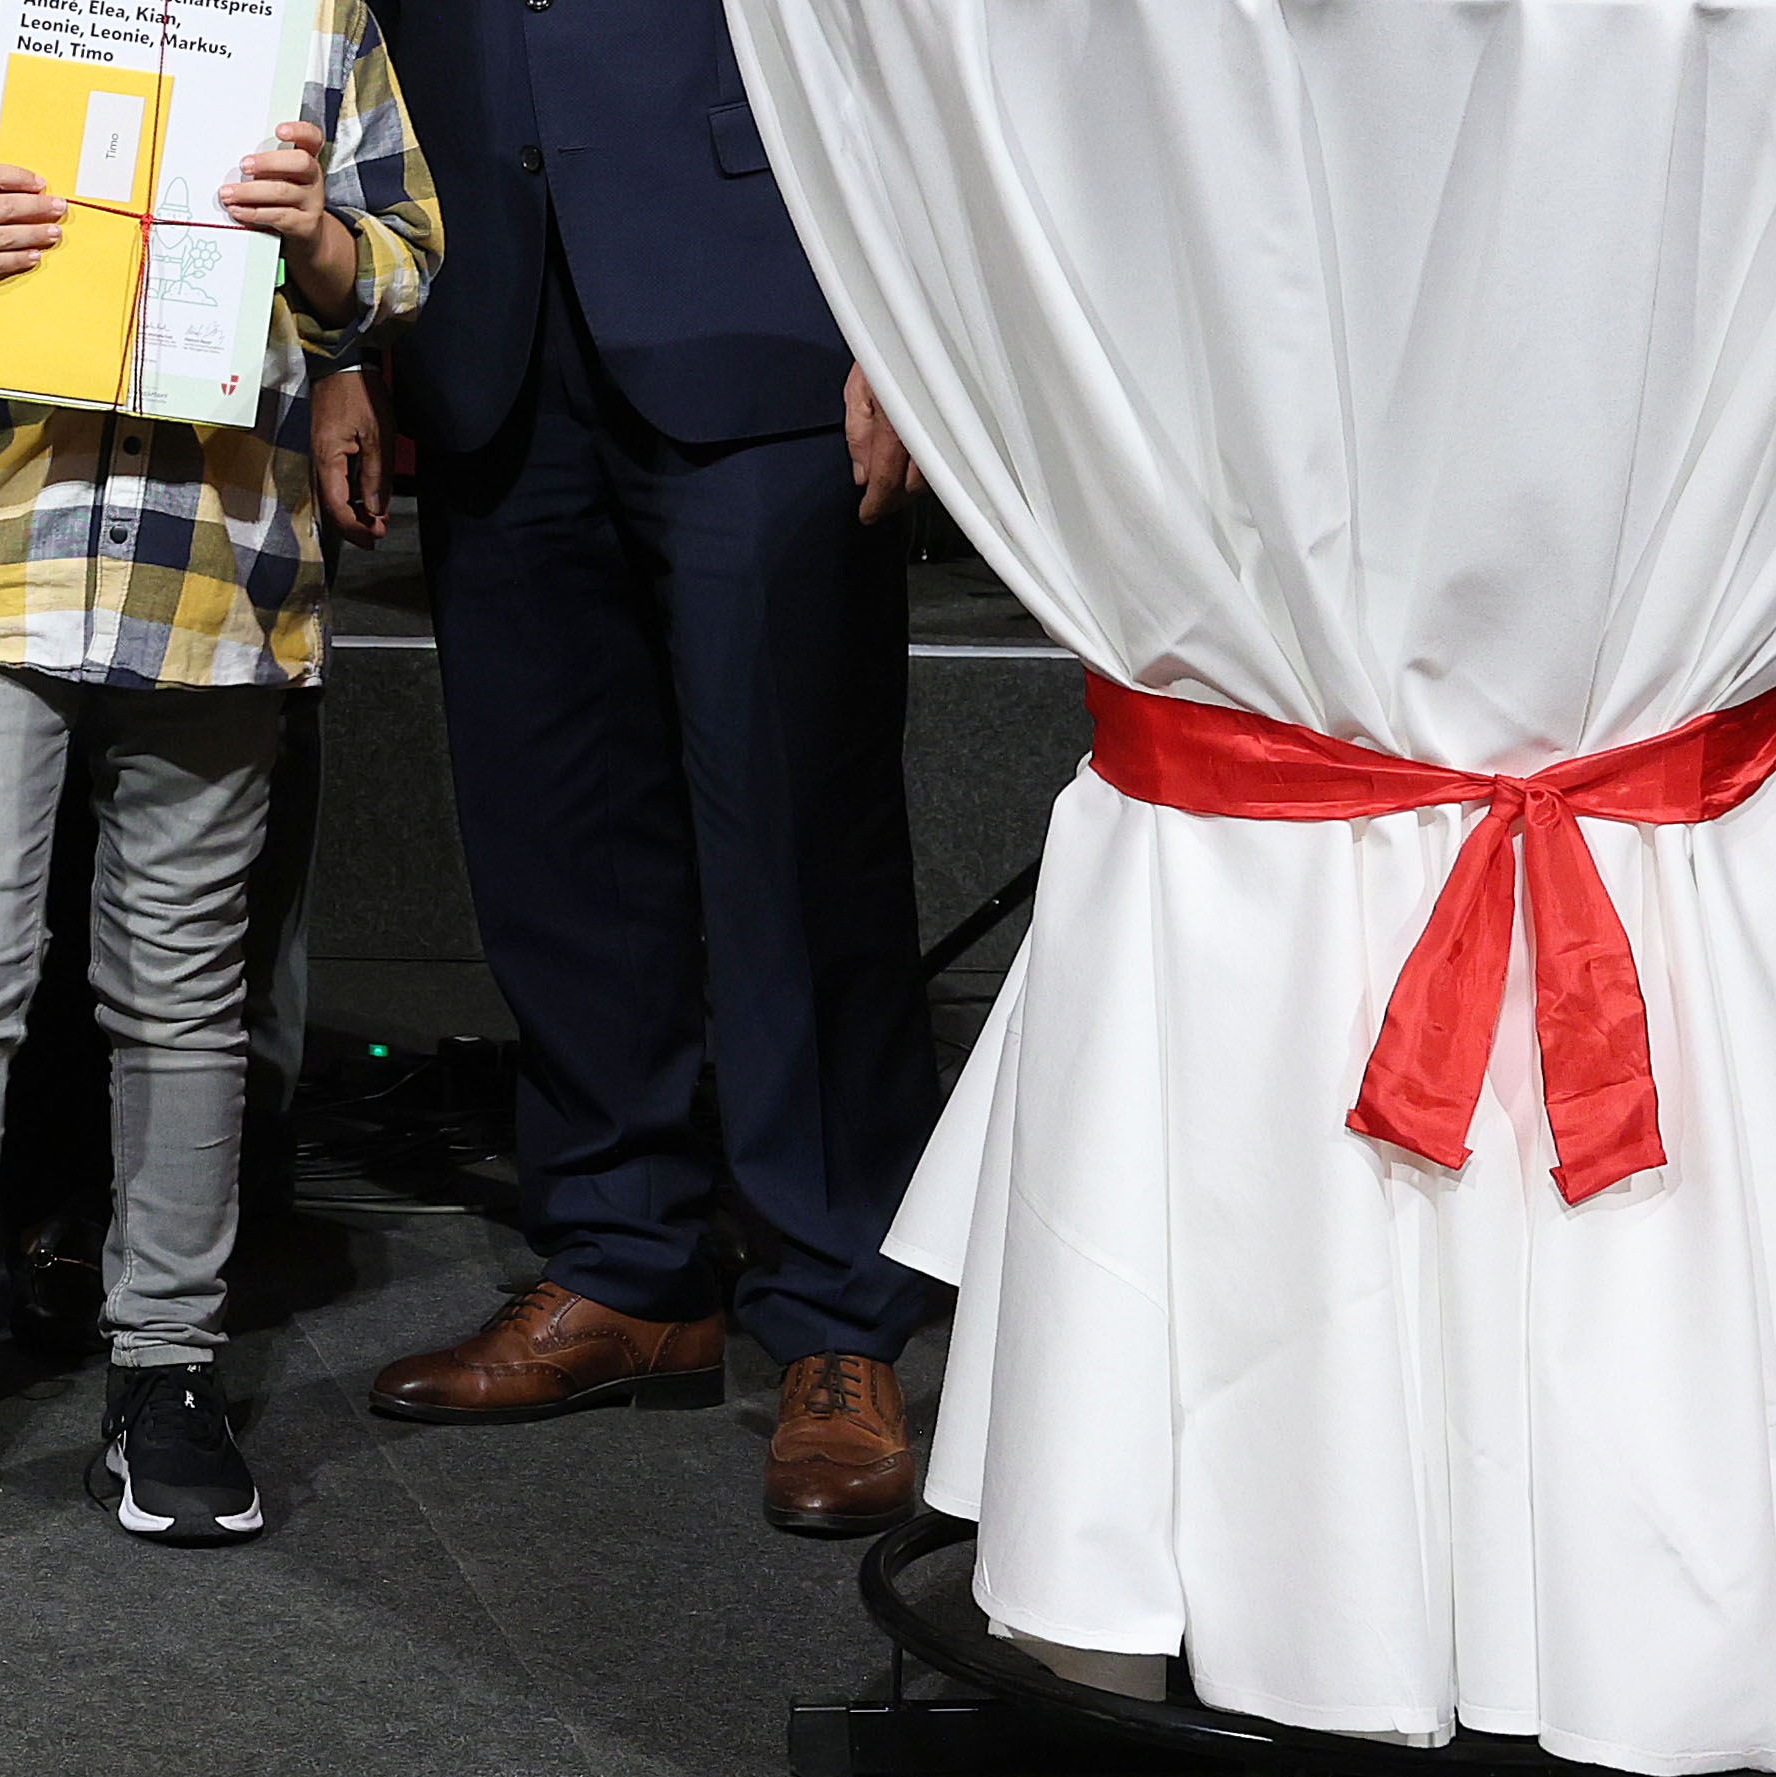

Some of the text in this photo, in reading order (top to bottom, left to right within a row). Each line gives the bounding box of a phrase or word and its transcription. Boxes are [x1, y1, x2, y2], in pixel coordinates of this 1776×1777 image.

[88, 0, 130, 22] Elea,
[135, 6, 181, 29] Kian,
[17, 35, 114, 62] Noel, Timo
[20, 12, 232, 59] Leonie, Leonie, Markus,
[105, 132, 120, 161] Timo
